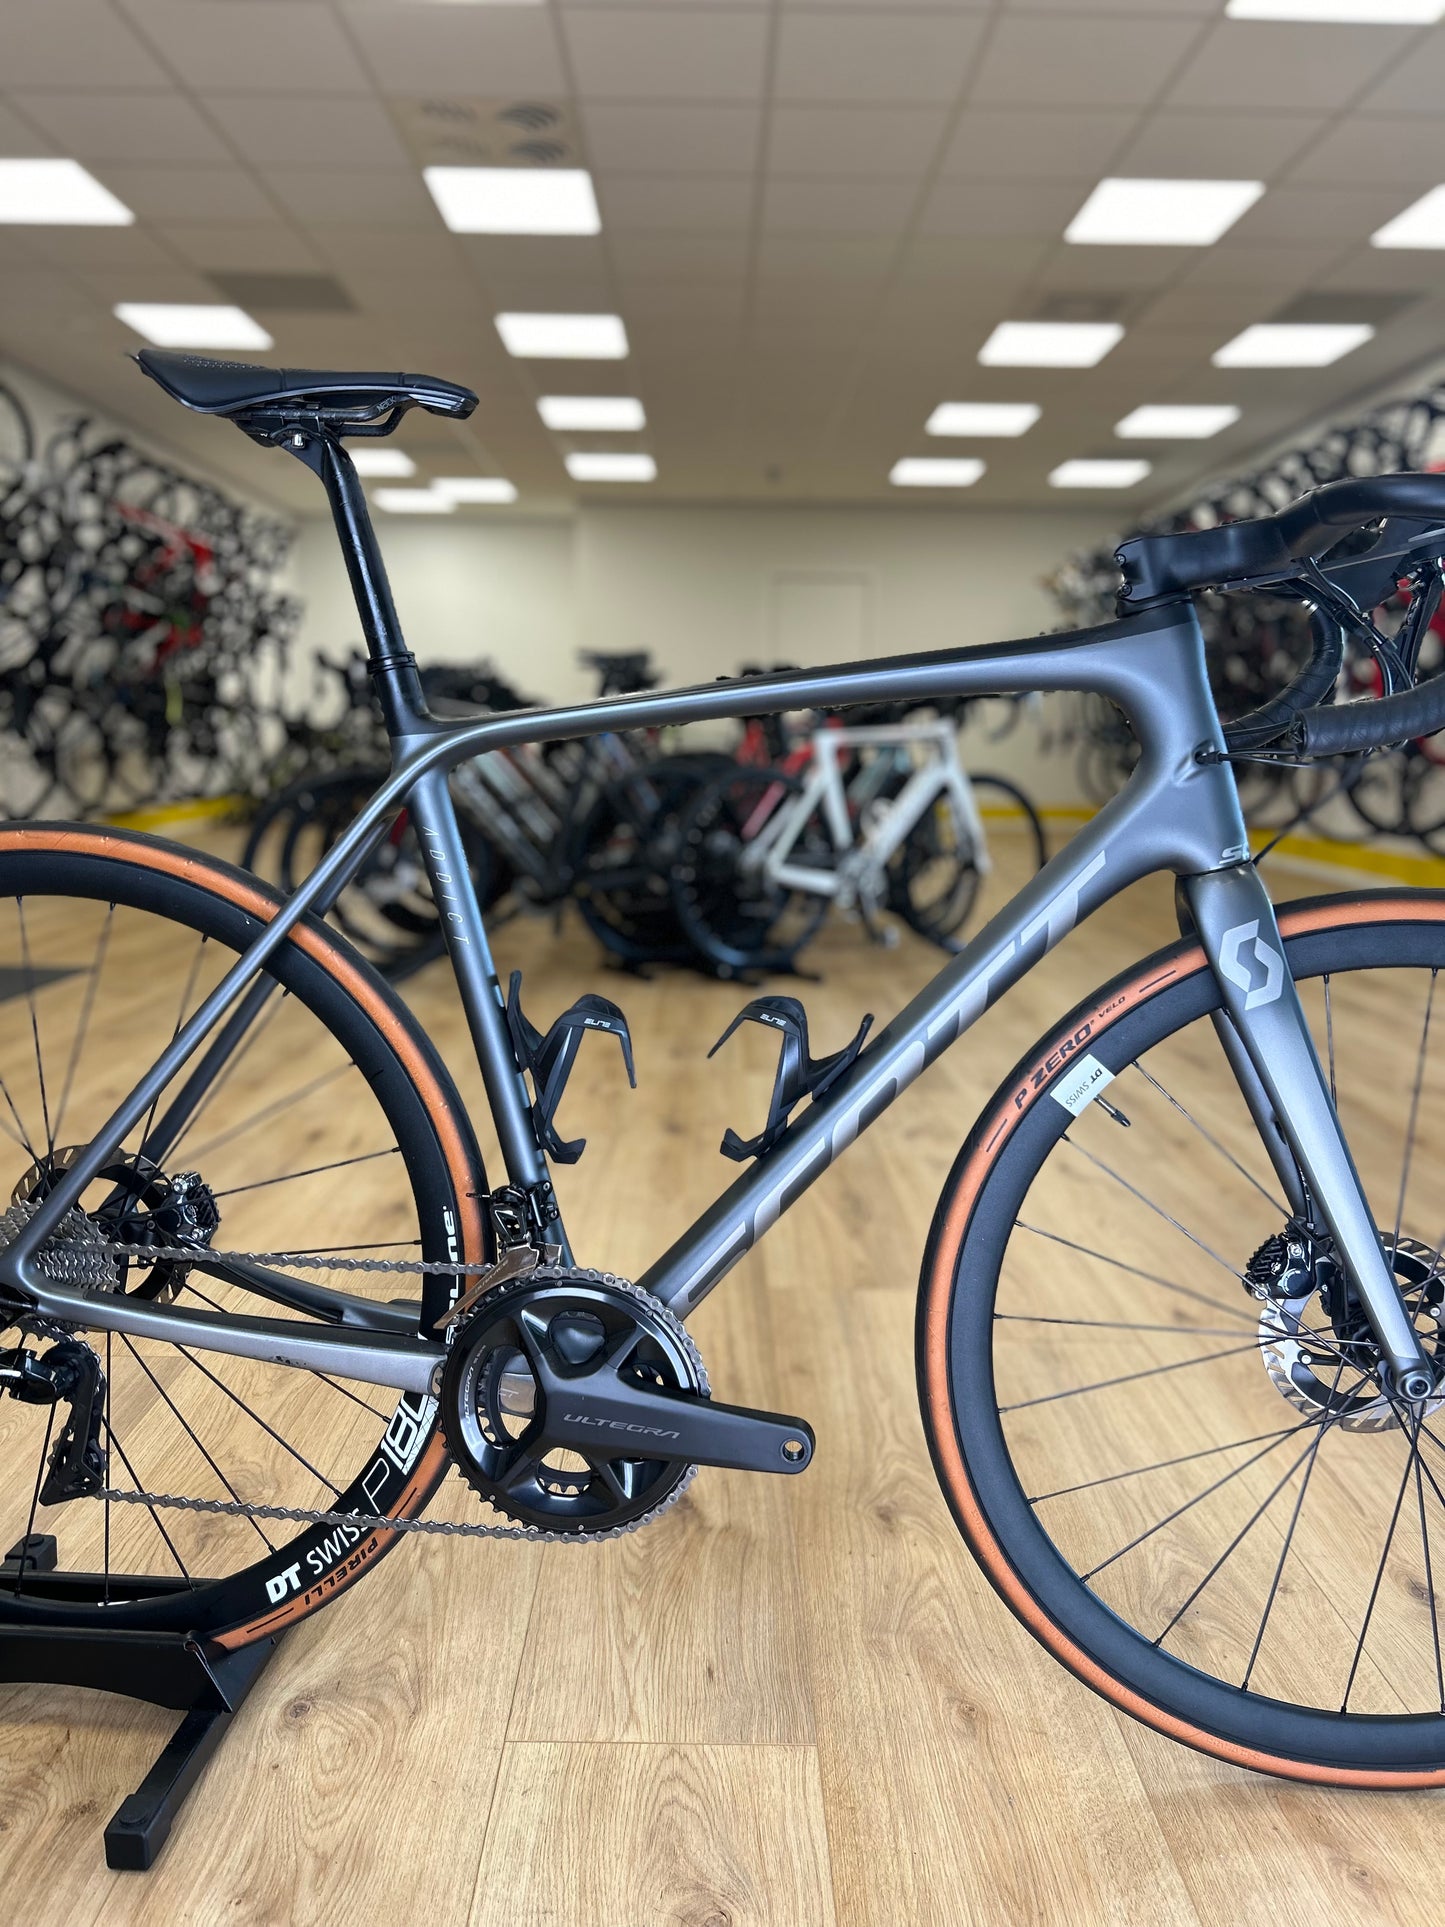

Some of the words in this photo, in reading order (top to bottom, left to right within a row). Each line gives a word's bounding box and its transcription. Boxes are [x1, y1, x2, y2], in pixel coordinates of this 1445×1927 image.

[422, 826, 470, 945] ADDICT
[1014, 1087, 1028, 1110] P
[1098, 995, 1126, 1018] VELO
[1065, 1081, 1090, 1108] SWISS
[1090, 1067, 1103, 1084] DT
[563, 1412, 681, 1440] ULTEGRA
[265, 1562, 302, 1604] DT
[303, 1536, 379, 1606] PIRELLI
